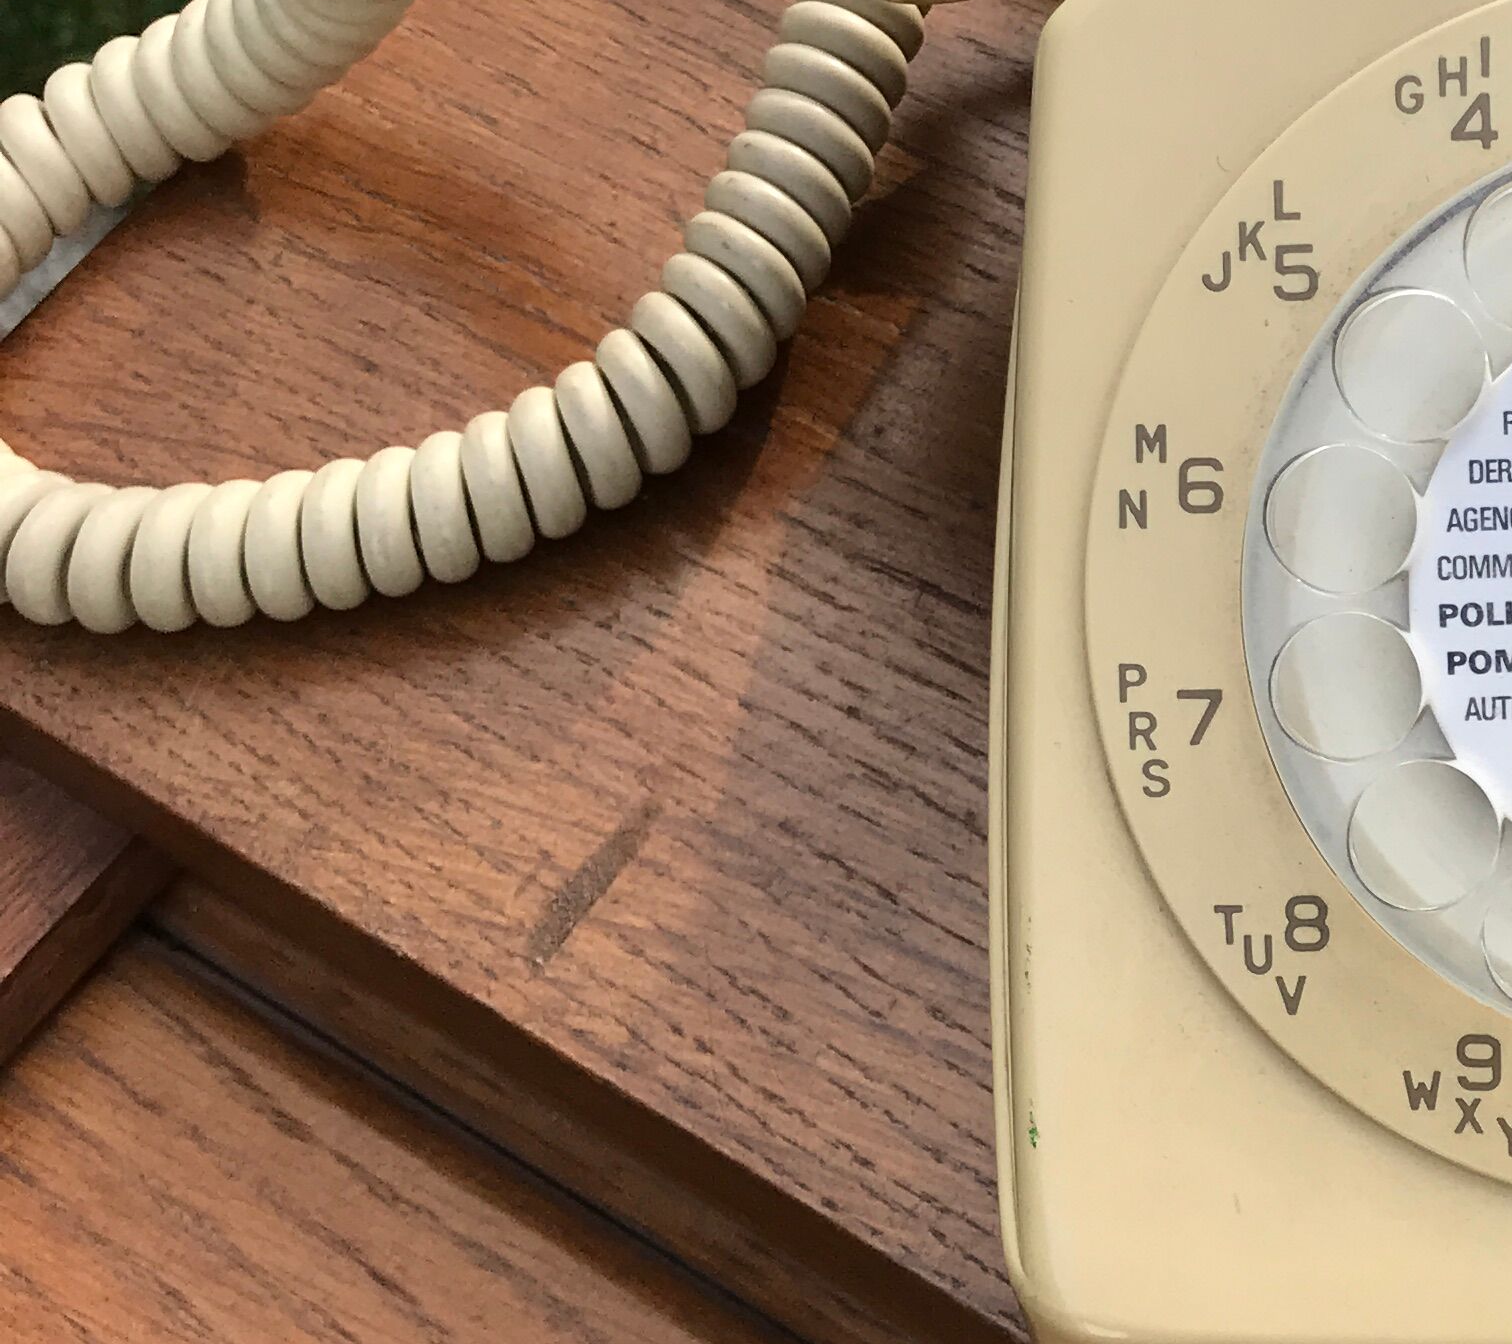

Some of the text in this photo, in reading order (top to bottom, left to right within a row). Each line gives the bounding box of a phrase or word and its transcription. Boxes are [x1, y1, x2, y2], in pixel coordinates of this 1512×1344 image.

[1450, 94, 1499, 150] 4
[1272, 244, 1319, 301] 5
[1176, 457, 1225, 515] 6
[1176, 688, 1223, 747] 7
[1284, 895, 1330, 952] 8
[1456, 1034, 1502, 1091] 9
